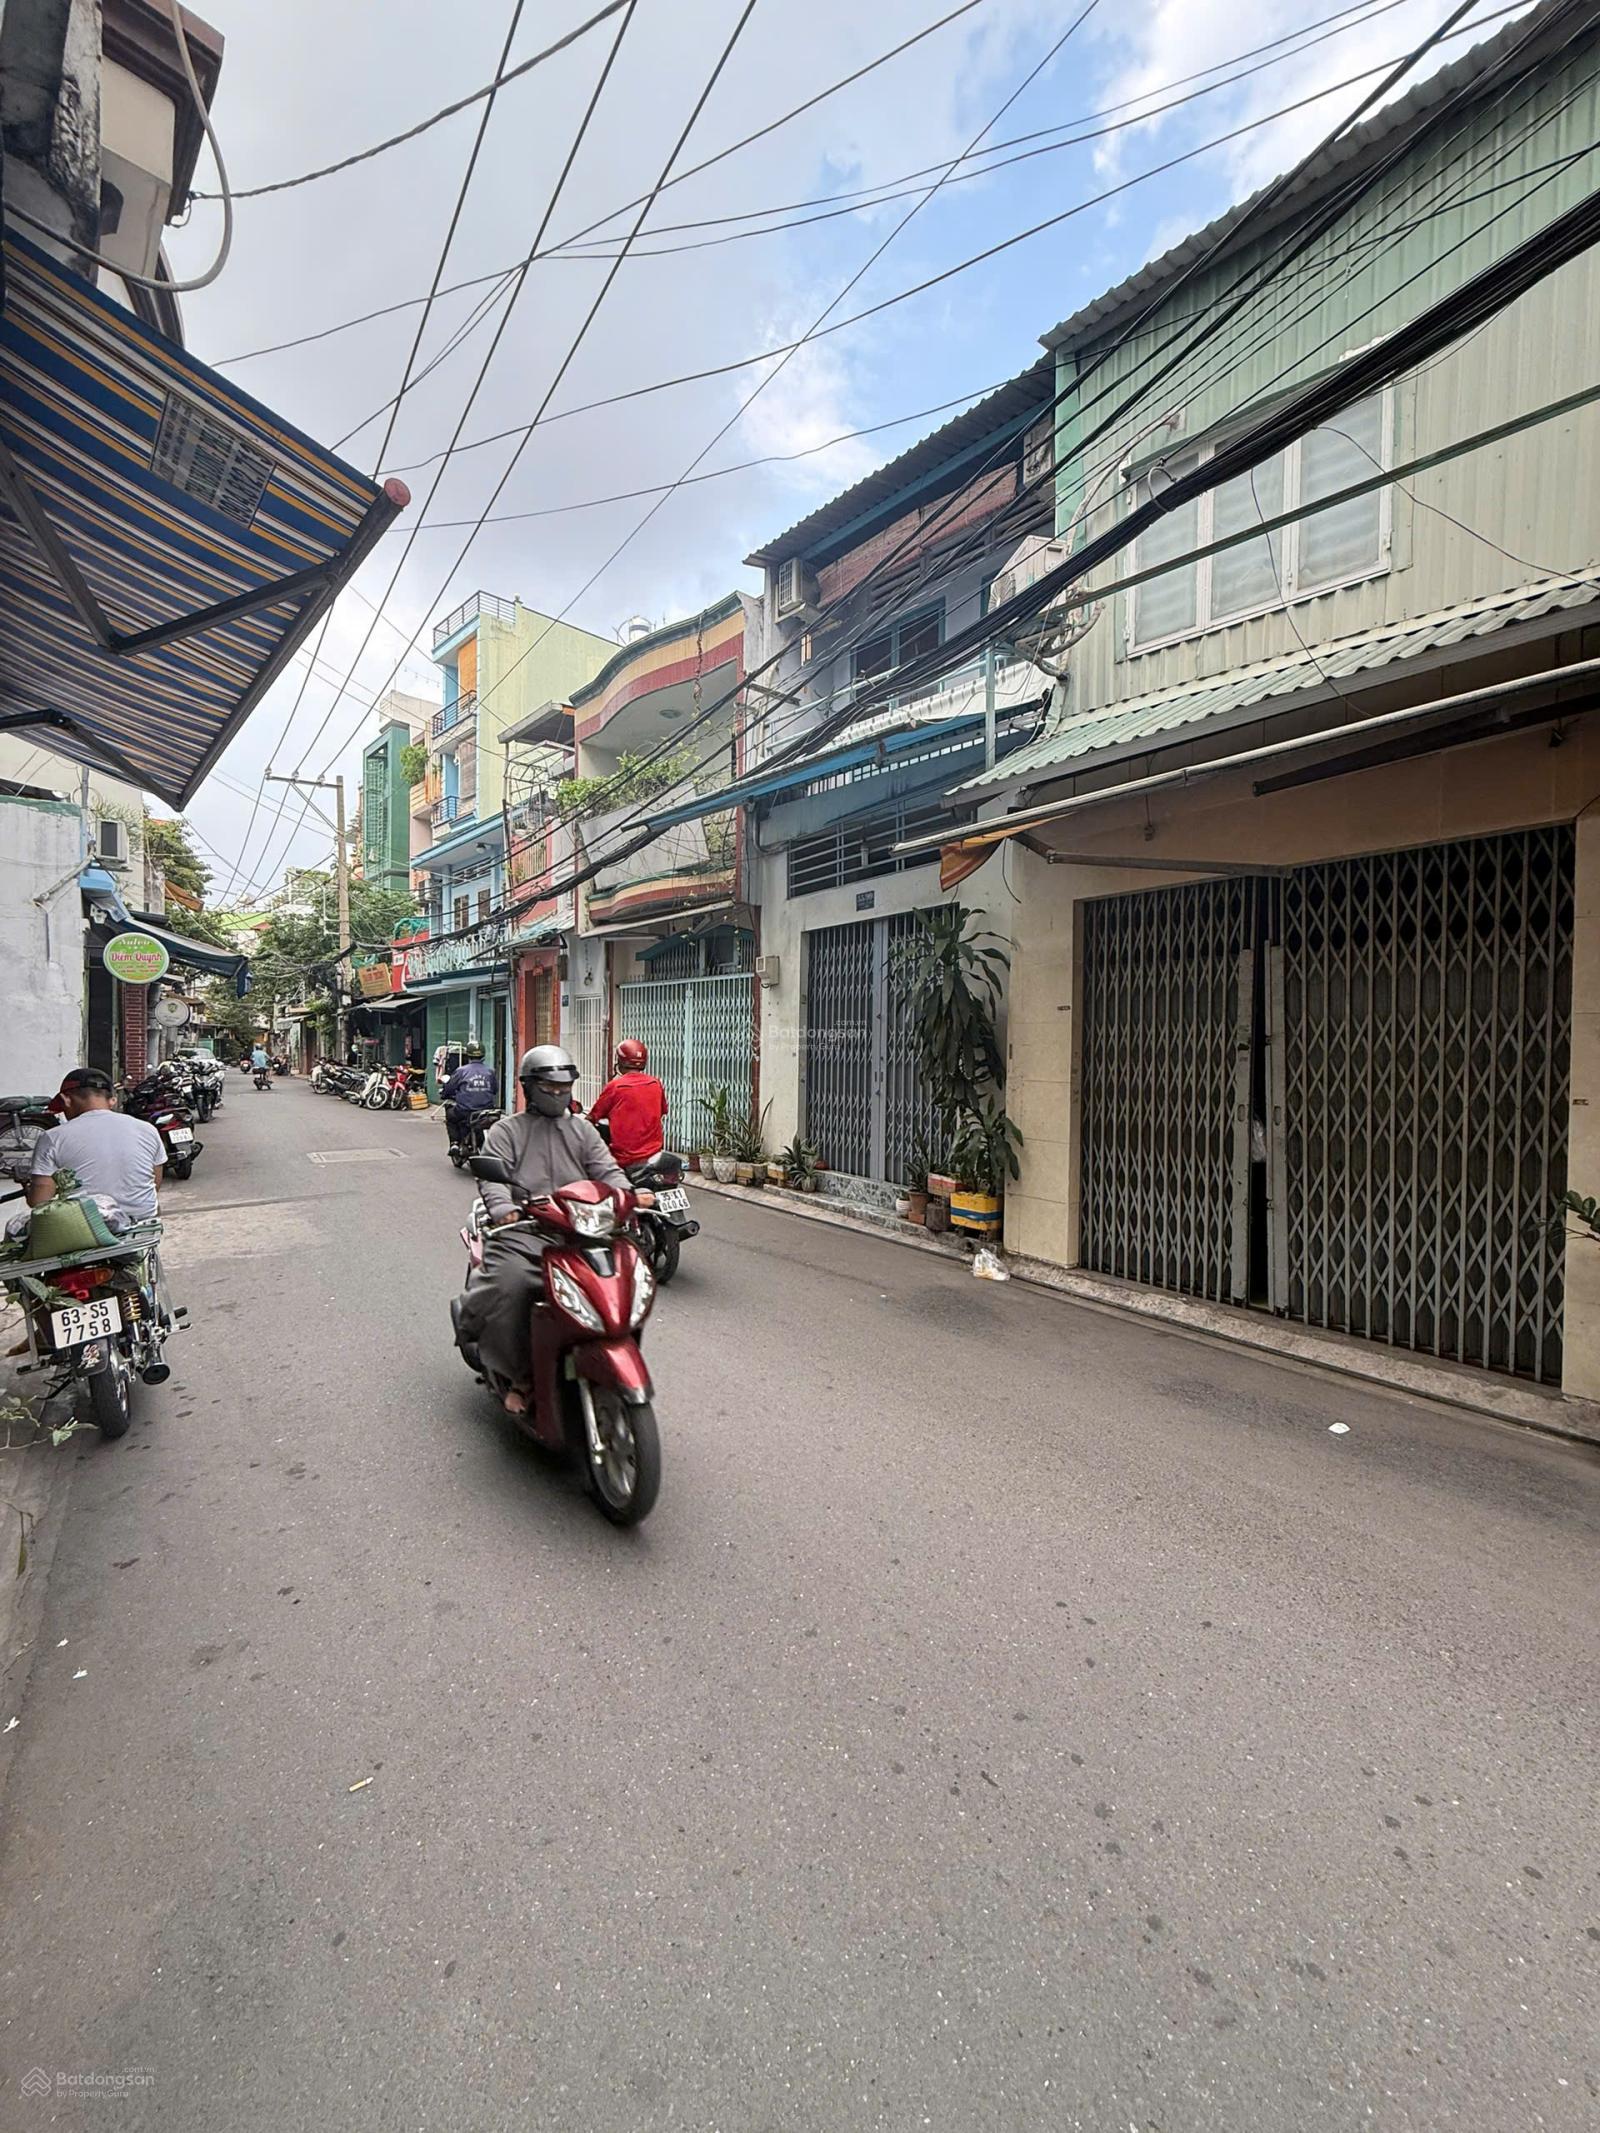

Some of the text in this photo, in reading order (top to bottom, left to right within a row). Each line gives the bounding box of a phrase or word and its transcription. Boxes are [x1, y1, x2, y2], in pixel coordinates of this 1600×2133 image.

[216, 440, 273, 525] 0904.812.713
[61, 1301, 109, 1327] 63-S5
[63, 1318, 111, 1344] 7758
